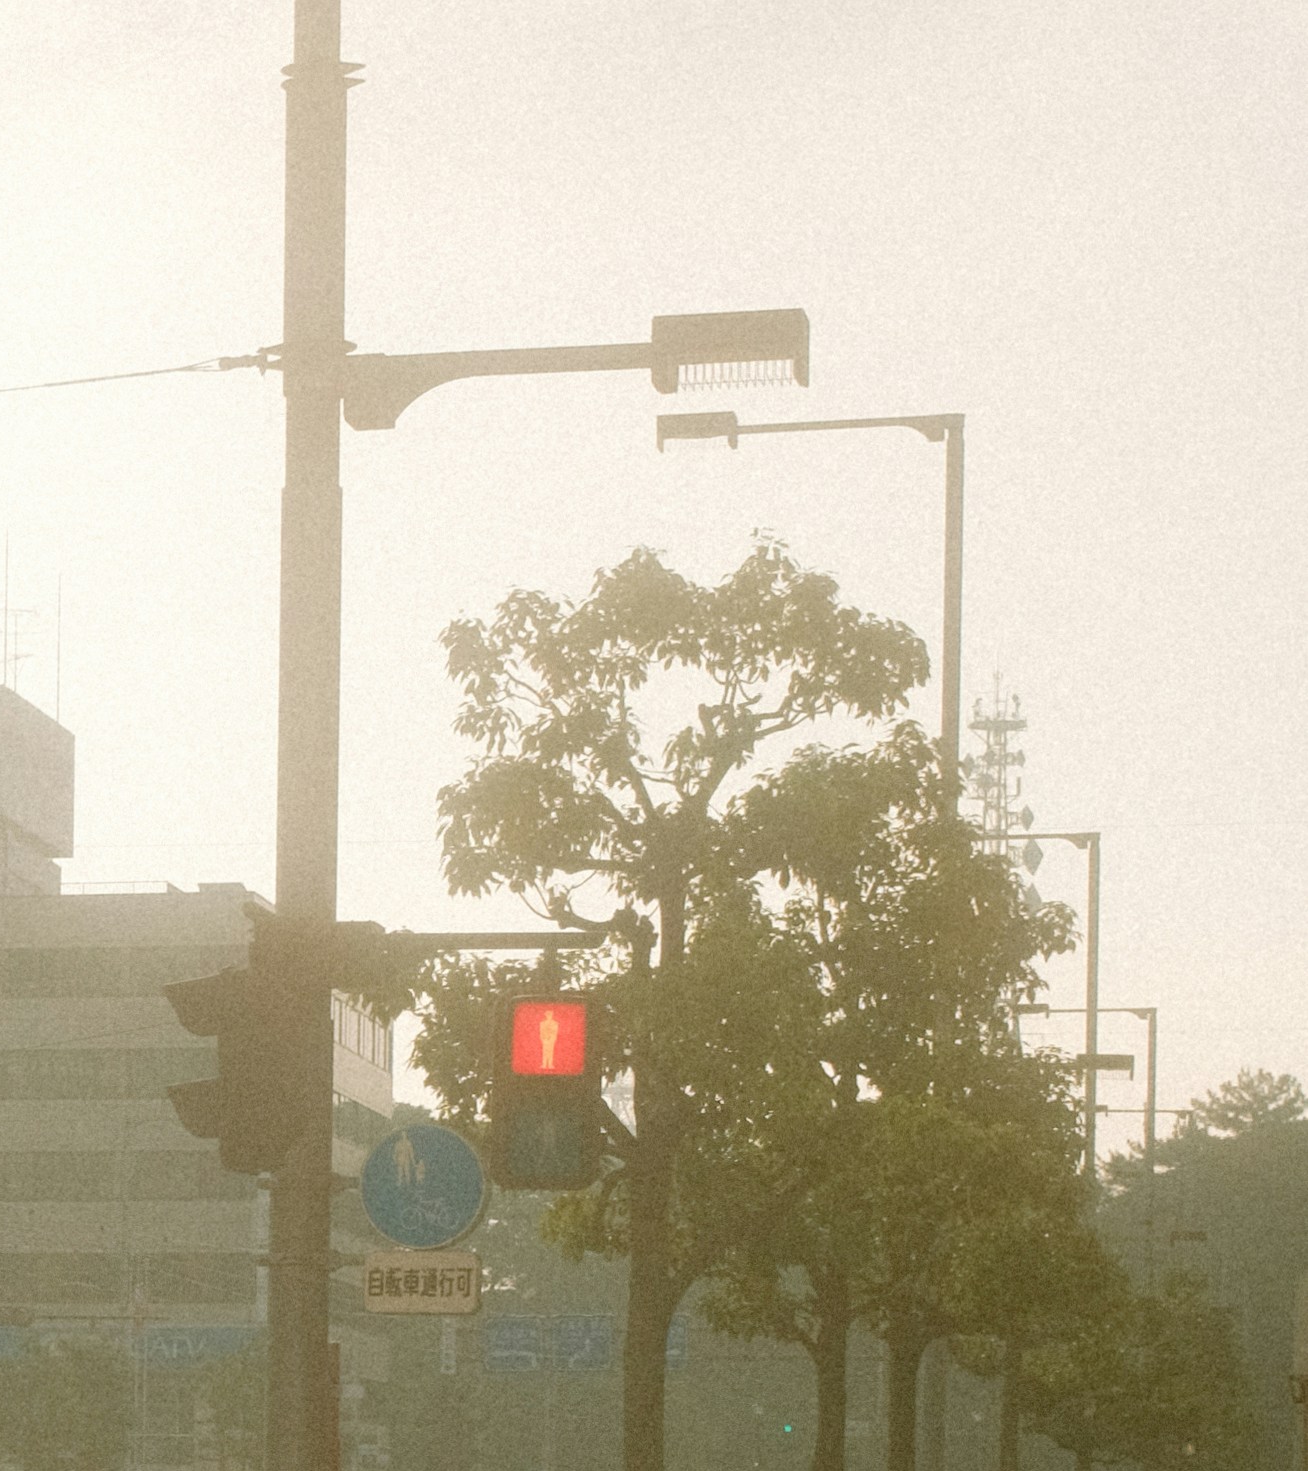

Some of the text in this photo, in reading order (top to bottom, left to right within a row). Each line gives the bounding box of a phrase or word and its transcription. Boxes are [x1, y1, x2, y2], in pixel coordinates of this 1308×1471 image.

[368, 1267, 474, 1299] 自転車通行可
